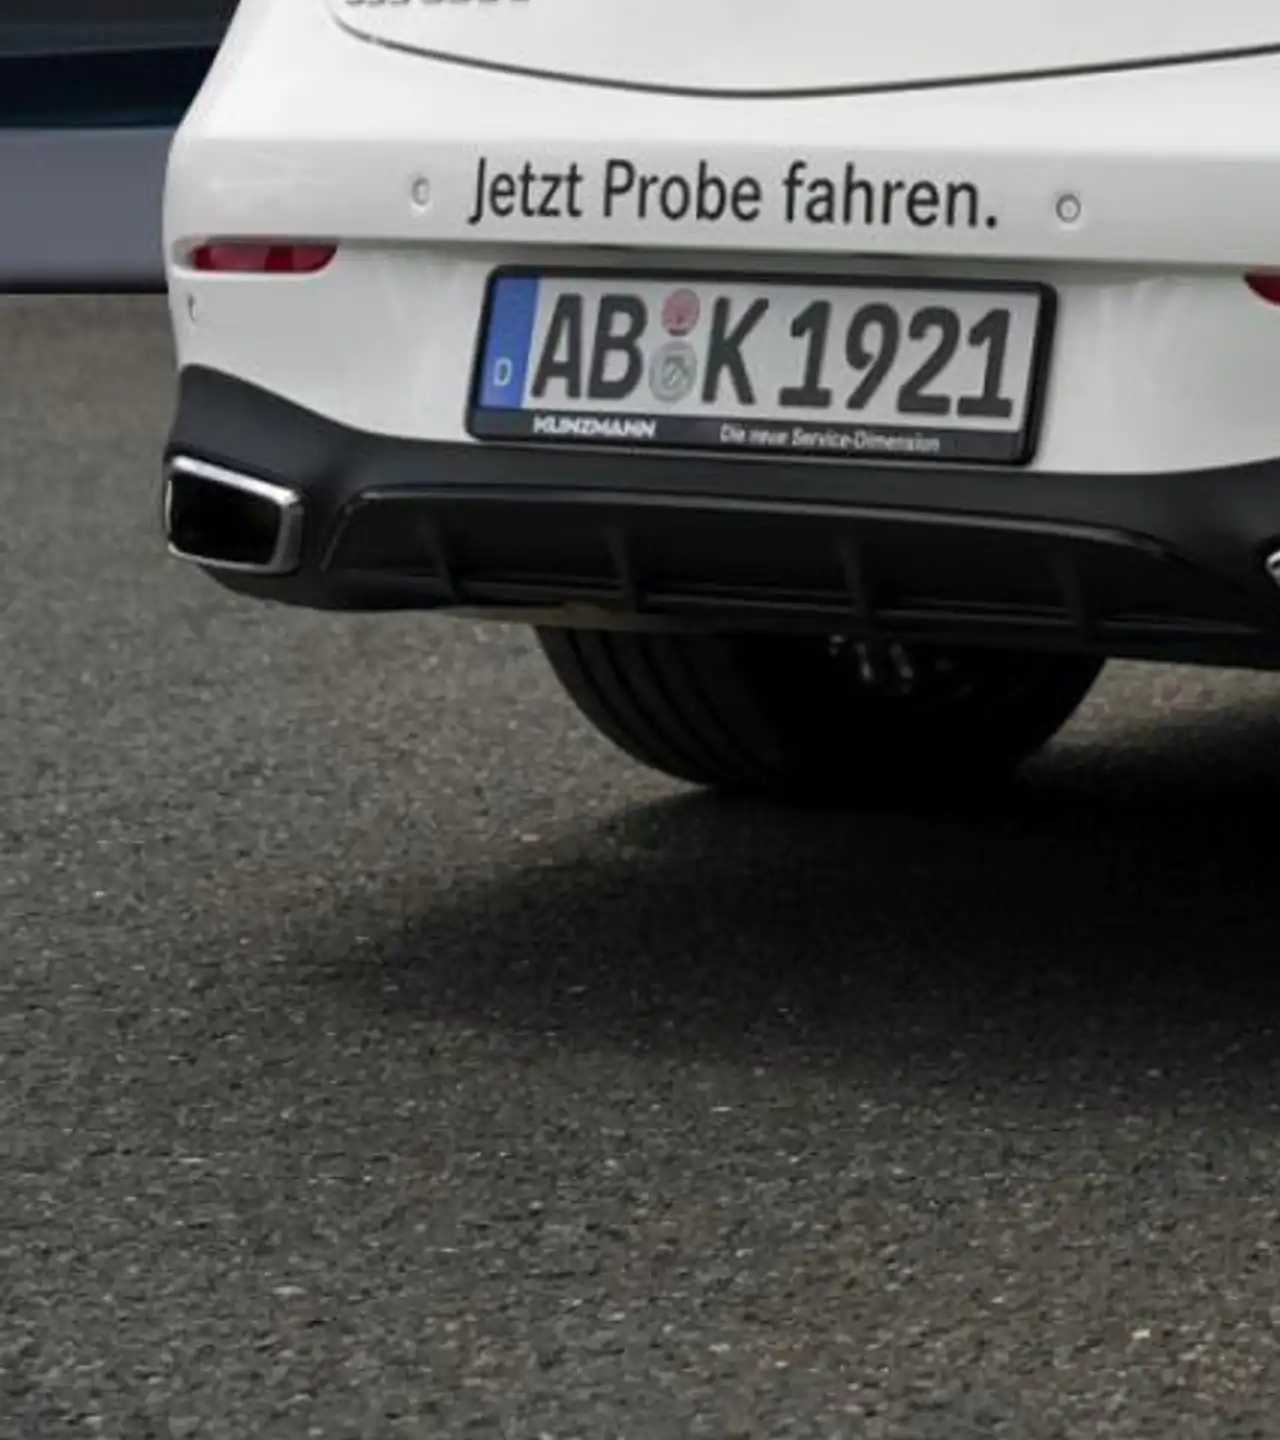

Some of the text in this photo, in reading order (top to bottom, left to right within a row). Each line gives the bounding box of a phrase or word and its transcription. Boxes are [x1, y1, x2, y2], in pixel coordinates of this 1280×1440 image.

[467, 156, 998, 229] Jetzt Probe fahren.
[532, 414, 656, 439] KUNZMANN
[719, 423, 746, 444] Die
